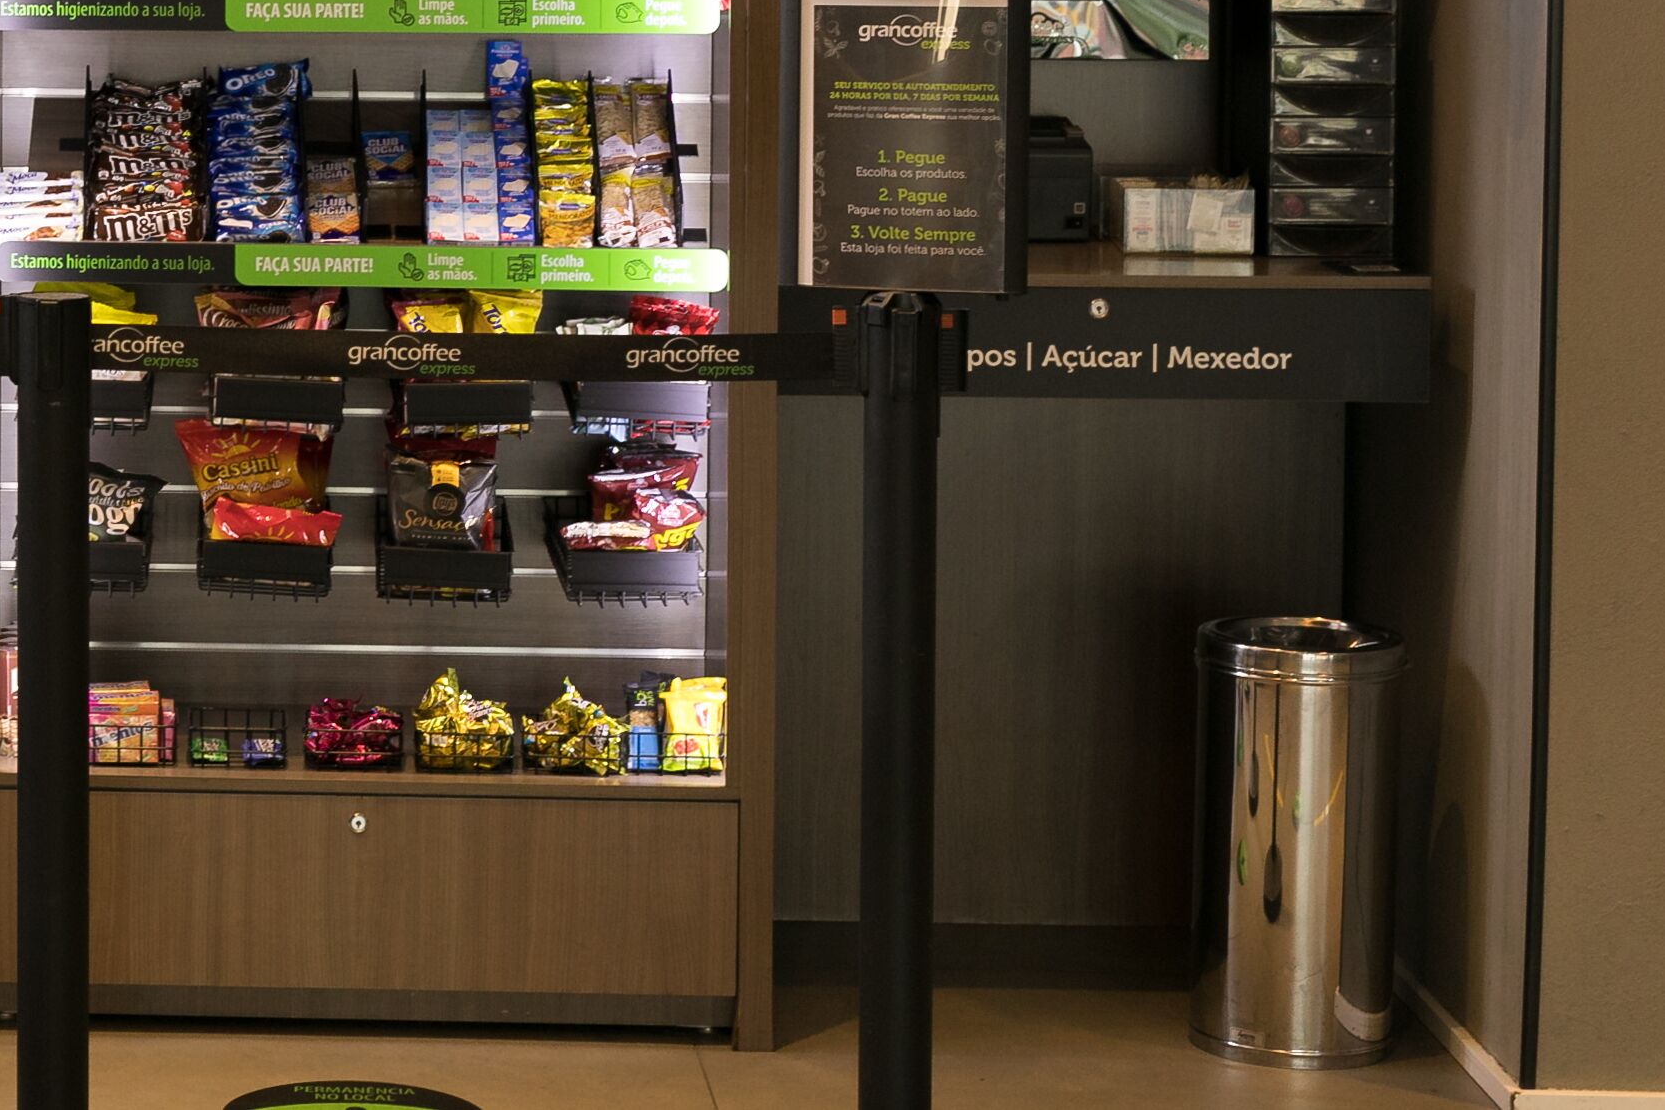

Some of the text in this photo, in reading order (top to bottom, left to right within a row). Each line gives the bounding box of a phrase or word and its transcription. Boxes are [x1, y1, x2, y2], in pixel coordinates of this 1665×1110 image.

[0, 0, 206, 21] Estamos higienizando a sua loja.
[245, 2, 365, 22] FAÇA SUA PARTE!
[418, 13, 469, 26] as mãos.
[531, 13, 586, 28] primeiro.
[858, 21, 959, 42] grancoffee
[225, 68, 277, 91] OREO
[834, 81, 996, 92] SEU SERVIÇO DE AUTOATENDIMENTO
[829, 92, 1000, 102] 24 HORAS POR DIA, 7 DIAS POR SEMANA
[368, 138, 399, 147] CLUB
[877, 150, 946, 168] 1. Pegue
[856, 166, 967, 181] Escolha os produtos.
[315, 198, 347, 208] CLUB
[878, 188, 948, 206] 2. Pague
[847, 204, 980, 218] Pague no totem ao lado.
[850, 225, 977, 245] 3. Volte Sempre
[840, 242, 955, 258] Esta loja foi feita para
[10, 253, 216, 274] Estamos higienizando a sua loja.
[254, 256, 374, 277] FAÇA SUA PARTE!
[427, 253, 465, 269] Limpe
[540, 254, 584, 268] Escolha
[427, 268, 477, 281] as mãos.
[540, 270, 594, 284] primeiro.
[347, 342, 461, 366] grancoffee
[625, 343, 741, 368] grancoffee
[1041, 343, 1294, 373] Açúcar Mexedor
[143, 355, 200, 370] express
[419, 362, 476, 377] express
[697, 363, 755, 378] express
[202, 452, 280, 483] Cassini
[293, 1084, 416, 1097] PERMANÊNCIA
[314, 1093, 397, 1102] NO LOCAL
